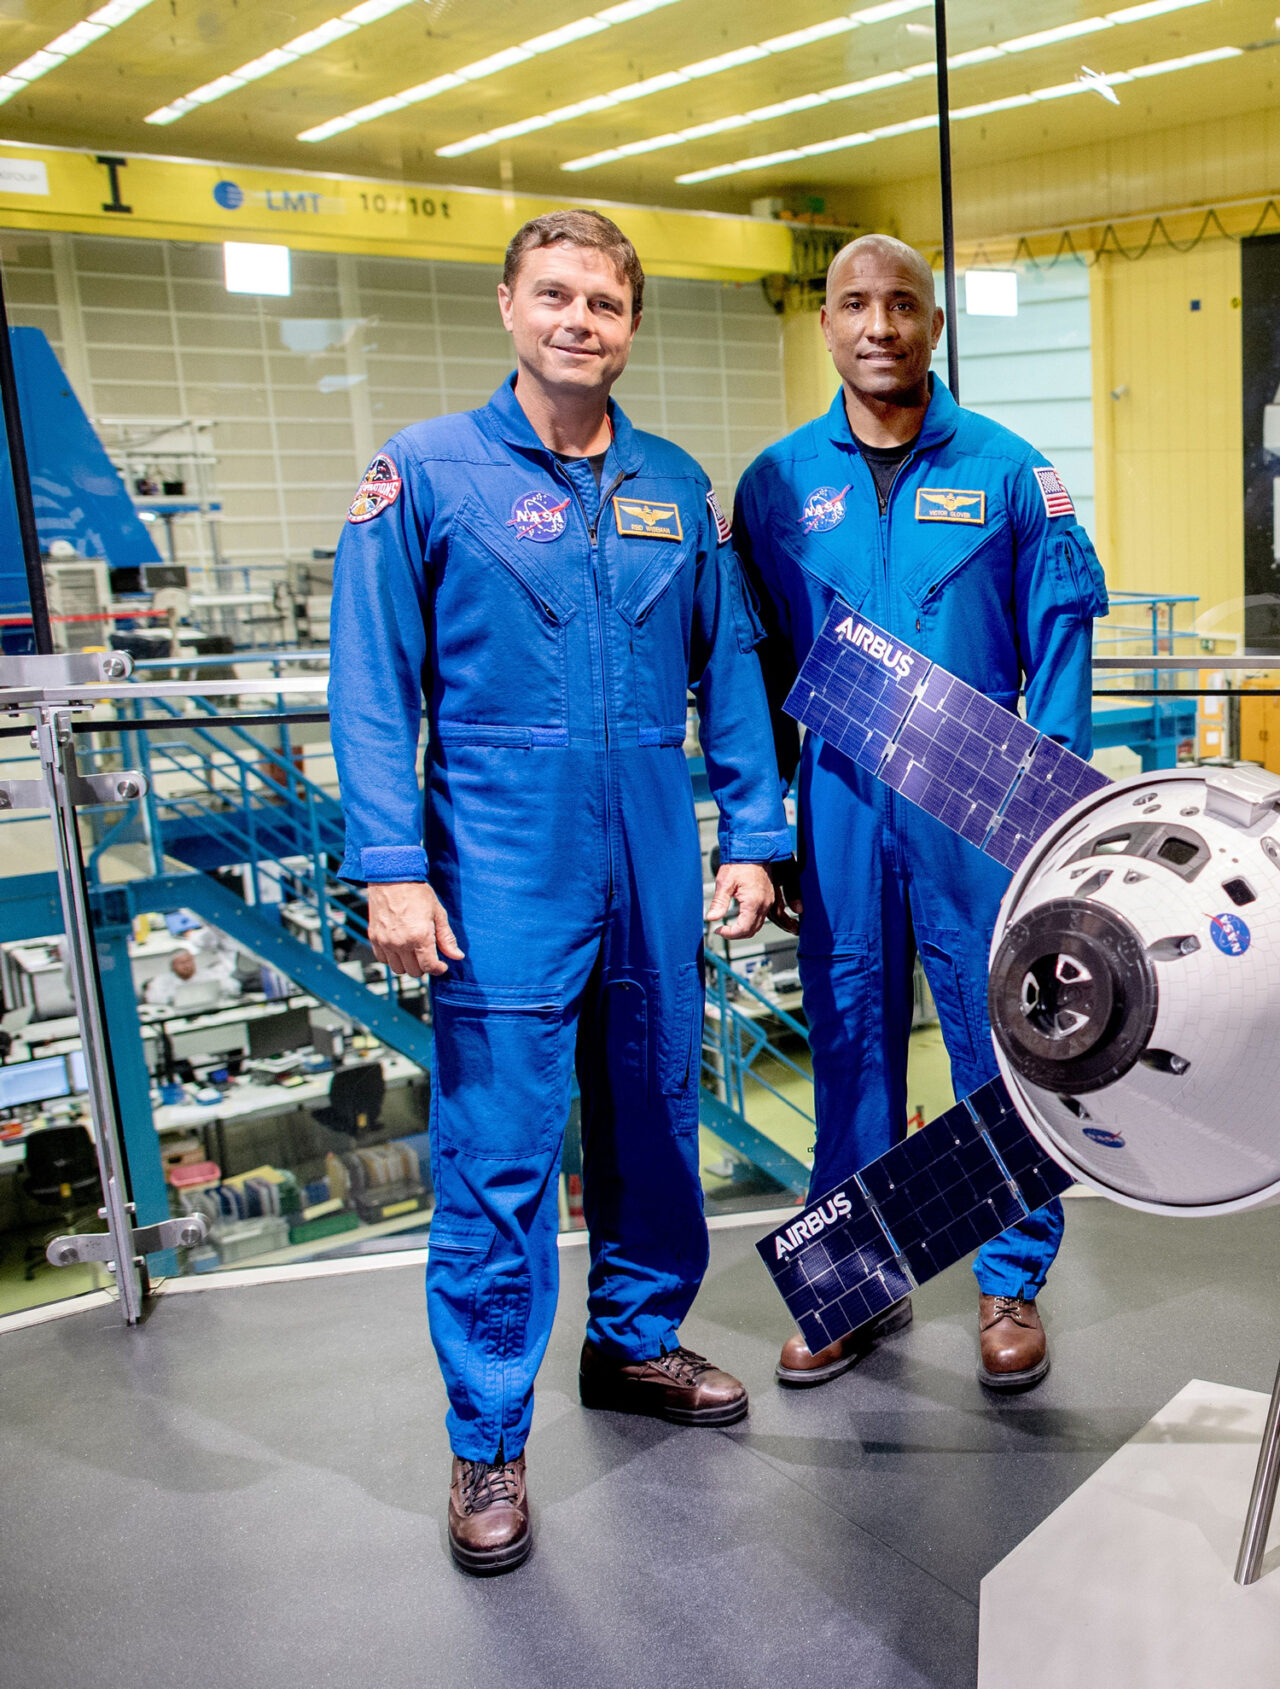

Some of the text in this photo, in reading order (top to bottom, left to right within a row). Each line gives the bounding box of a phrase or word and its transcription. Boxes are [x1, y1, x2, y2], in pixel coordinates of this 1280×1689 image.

[265, 190, 322, 213] LMT
[515, 510, 564, 523] NASA
[804, 501, 845, 518] NASA
[928, 509, 948, 517] VICTOR
[834, 616, 915, 677] AIRBUS
[1219, 914, 1242, 954] NASA
[775, 1191, 852, 1260] AIRBUS
